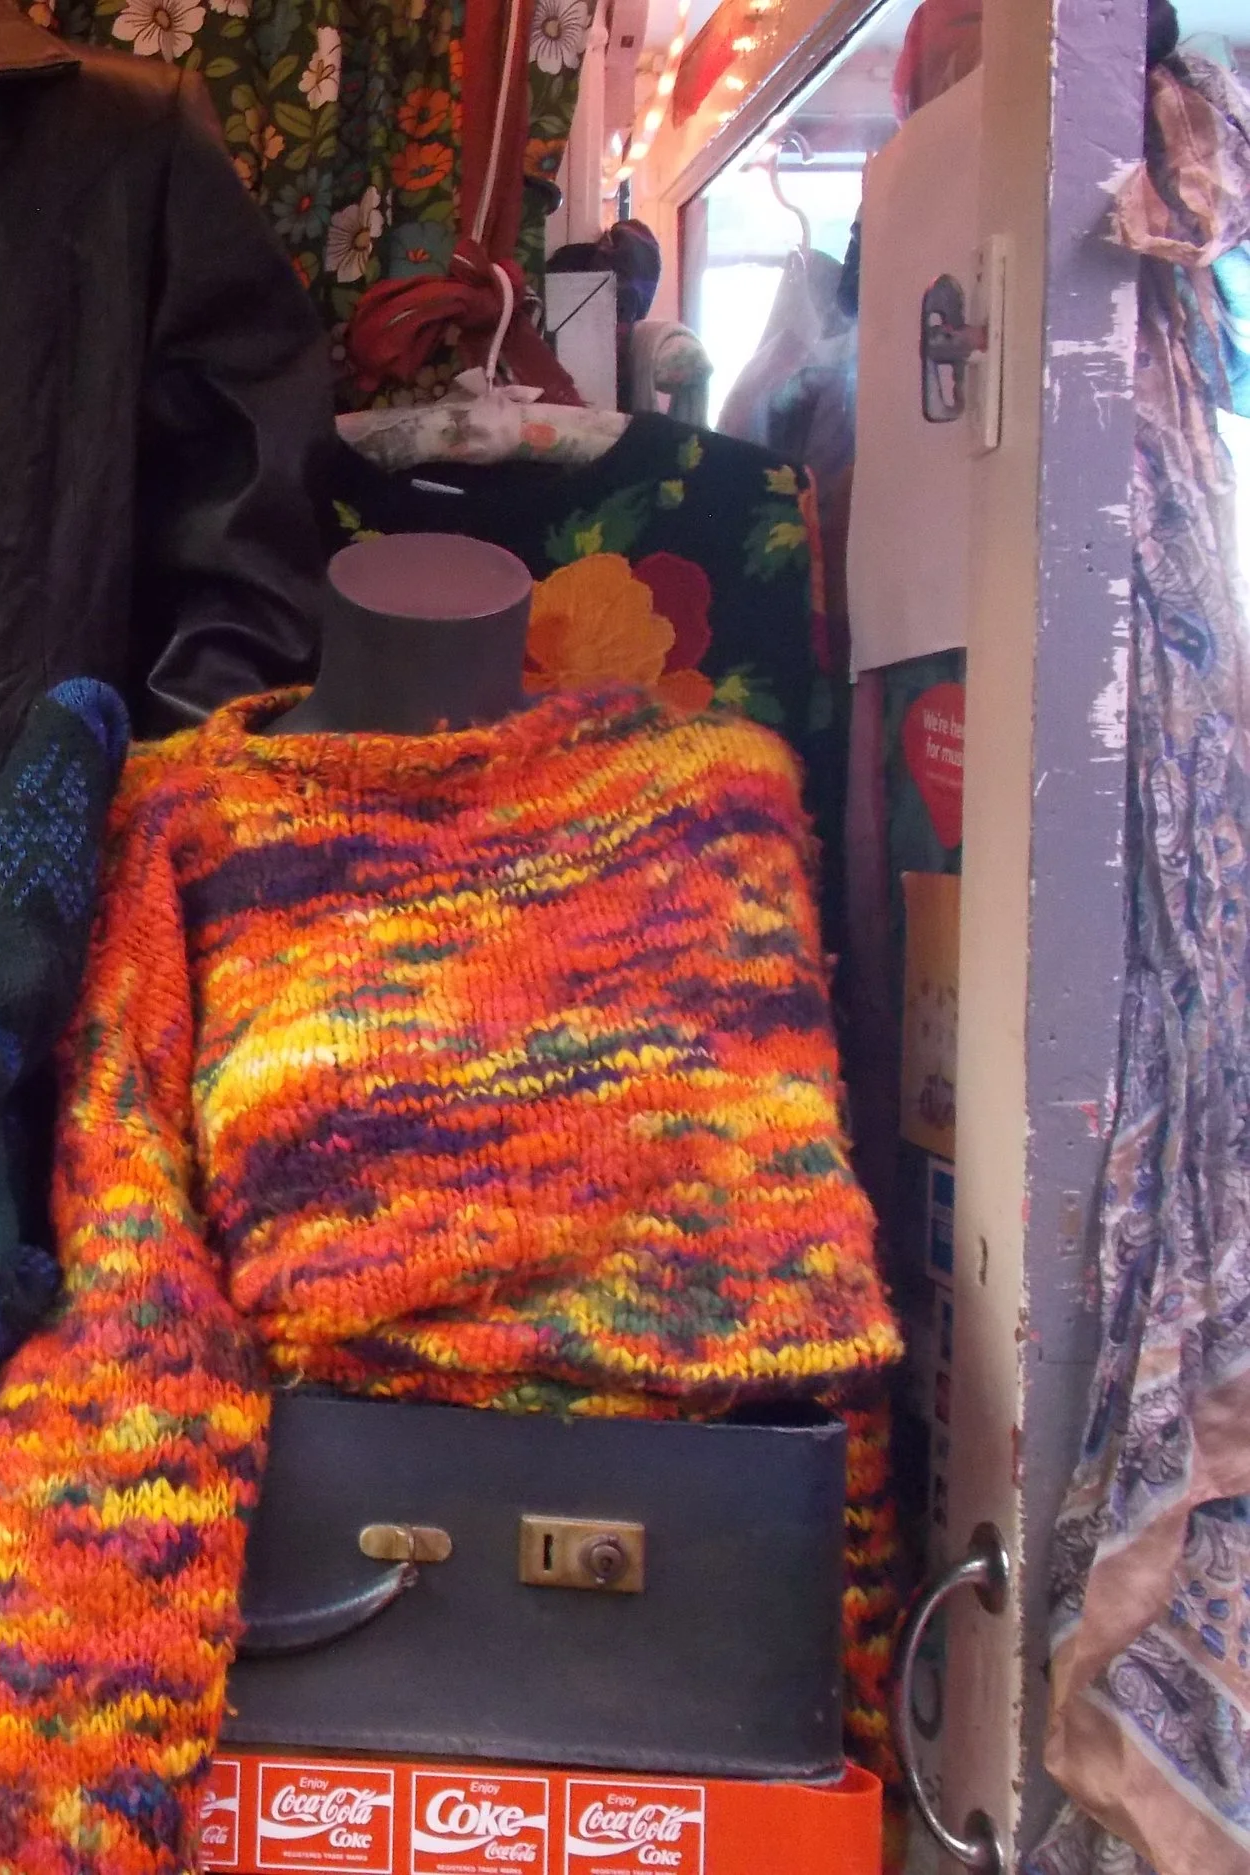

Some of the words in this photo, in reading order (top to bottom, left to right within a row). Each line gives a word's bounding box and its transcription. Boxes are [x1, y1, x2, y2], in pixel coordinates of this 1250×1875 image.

[926, 734, 941, 760] for
[299, 1776, 330, 1790] Enjoy
[469, 1781, 501, 1795] Enjoy
[606, 1792, 638, 1807] Enjoy
[425, 1788, 525, 1837] Coke
[328, 1827, 374, 1849] Coke
[637, 1844, 683, 1866] Coke
